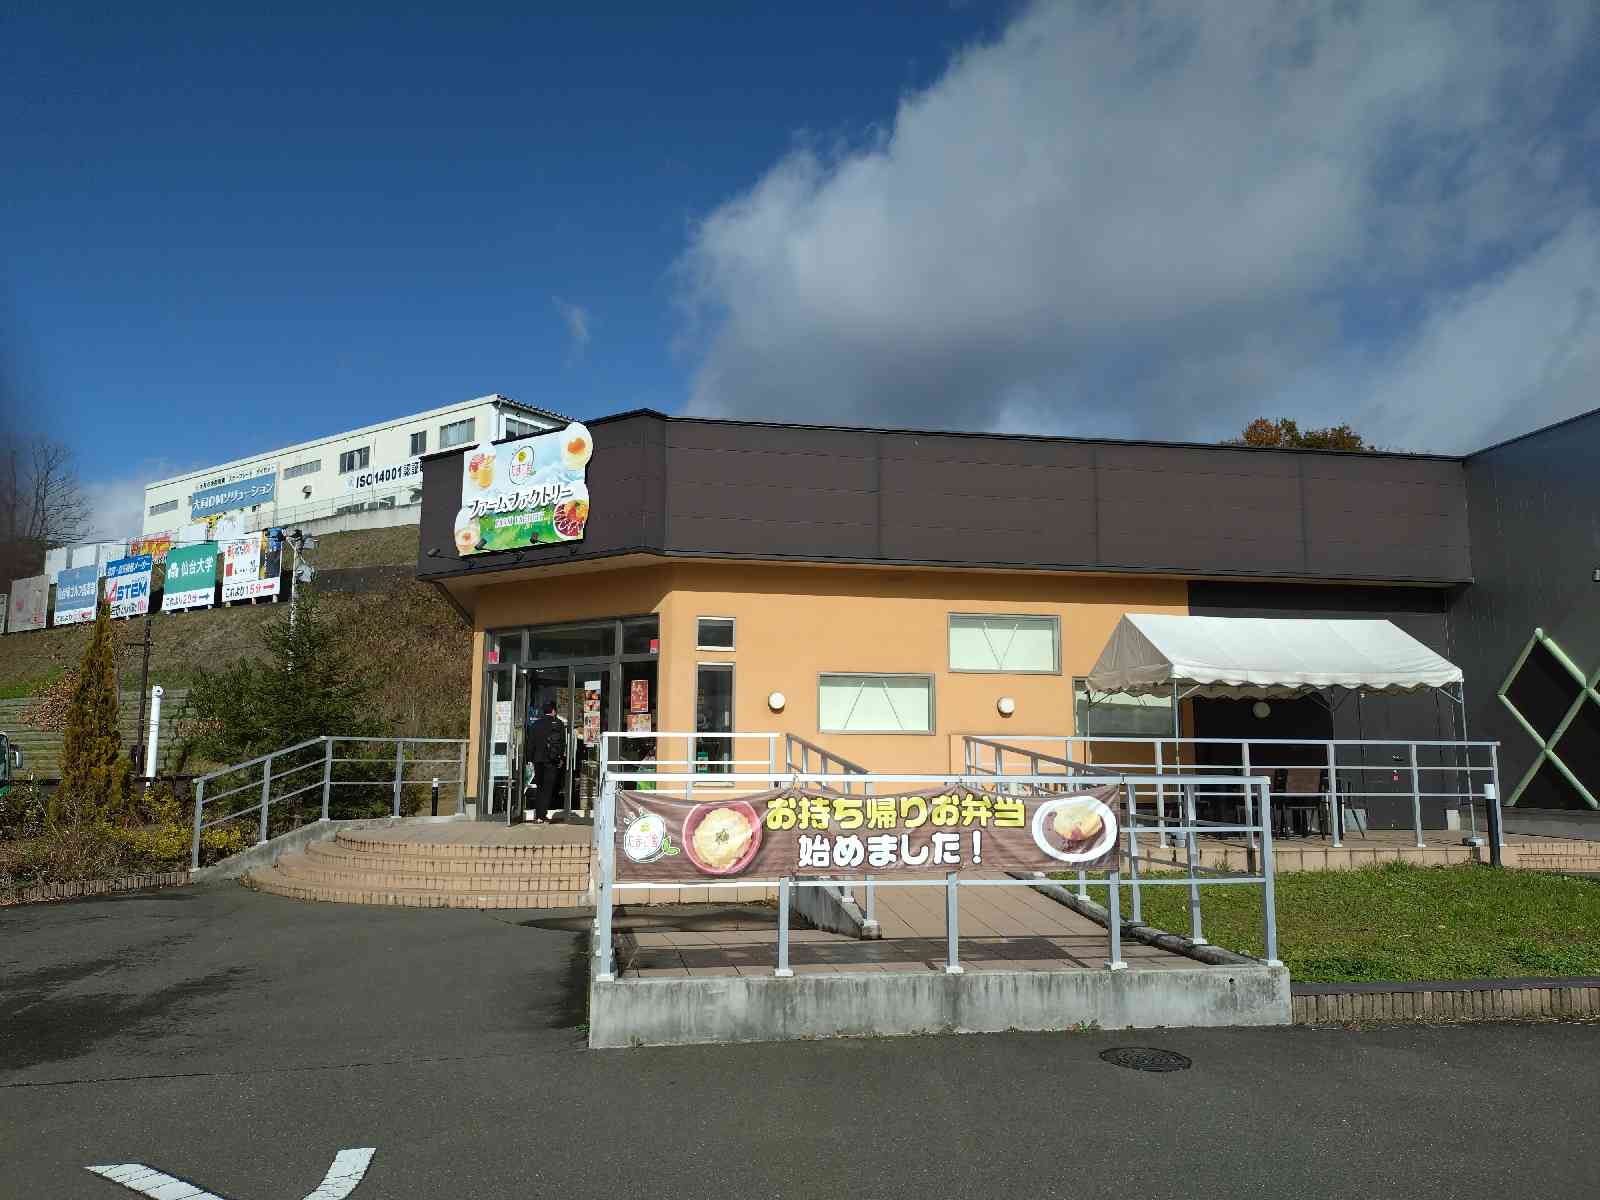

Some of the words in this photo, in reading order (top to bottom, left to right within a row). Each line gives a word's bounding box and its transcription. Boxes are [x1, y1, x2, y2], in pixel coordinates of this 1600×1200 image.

[468, 483, 573, 519] ファームファクトリー
[181, 557, 214, 577] 仙台大学
[766, 795, 1026, 830] お持ち帰りお弁当
